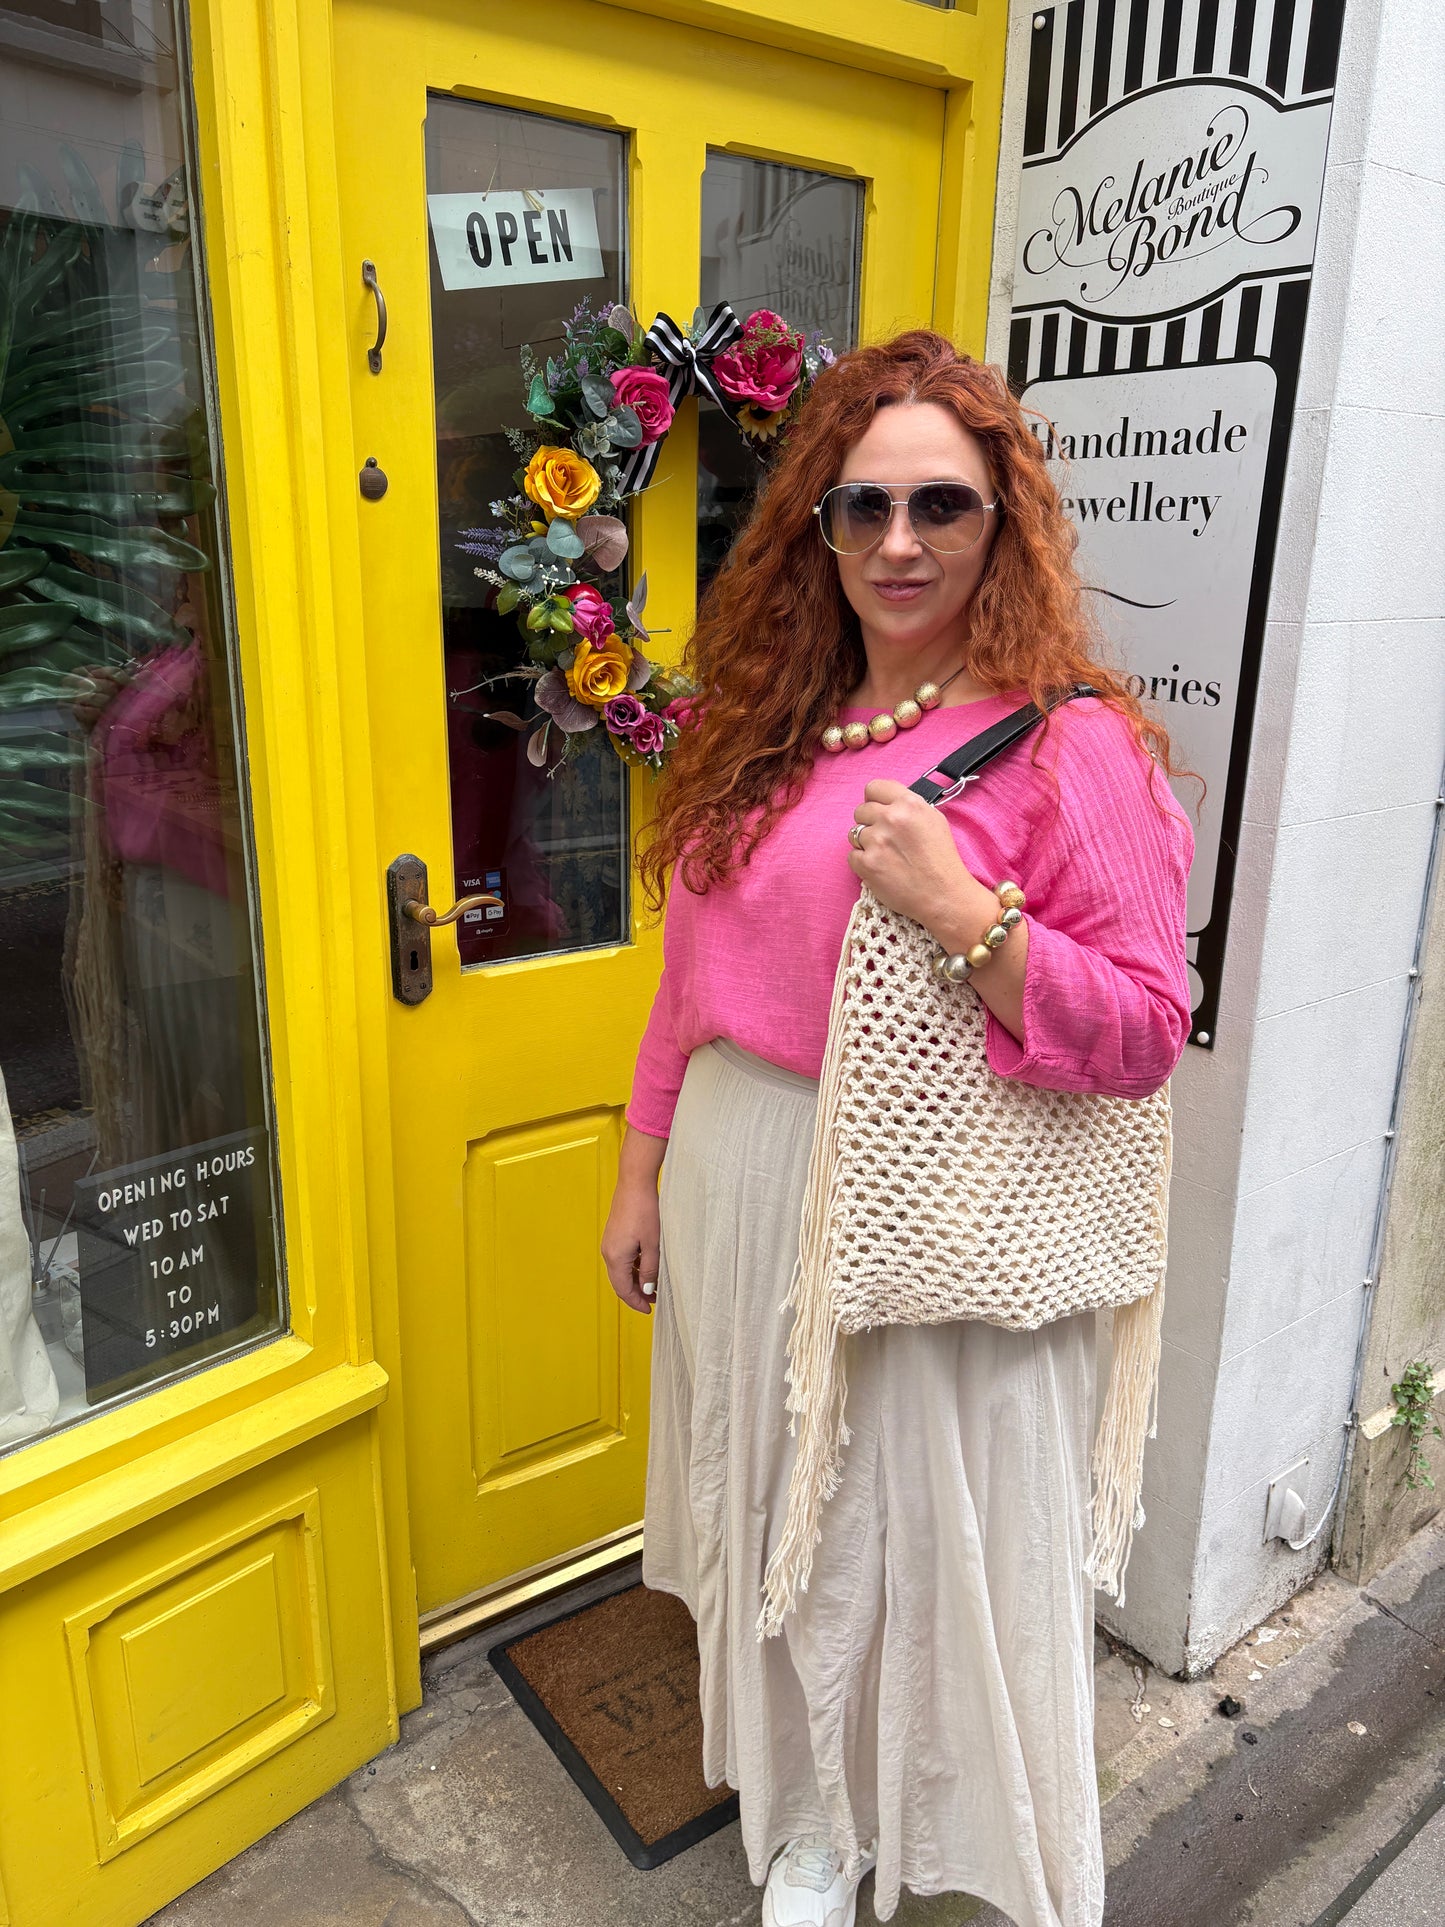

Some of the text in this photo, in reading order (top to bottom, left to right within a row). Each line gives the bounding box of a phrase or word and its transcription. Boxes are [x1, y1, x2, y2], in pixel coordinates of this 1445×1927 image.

[1023, 105, 1249, 274] Melanie
[1168, 173, 1238, 221] Boutique
[466, 209, 573, 268] OPEN
[1081, 151, 1302, 303] Bond
[1028, 410, 1248, 461] Handmade
[1058, 481, 1222, 537] ewellery
[1125, 664, 1221, 707] ories
[462, 878, 480, 888] VISA
[98, 1147, 255, 1212] OPENING HOURS
[123, 1196, 229, 1247] WED TO SAT
[150, 1245, 204, 1279] 10 AM
[167, 1286, 192, 1308] TO
[145, 1304, 219, 1348] 5:30PM
